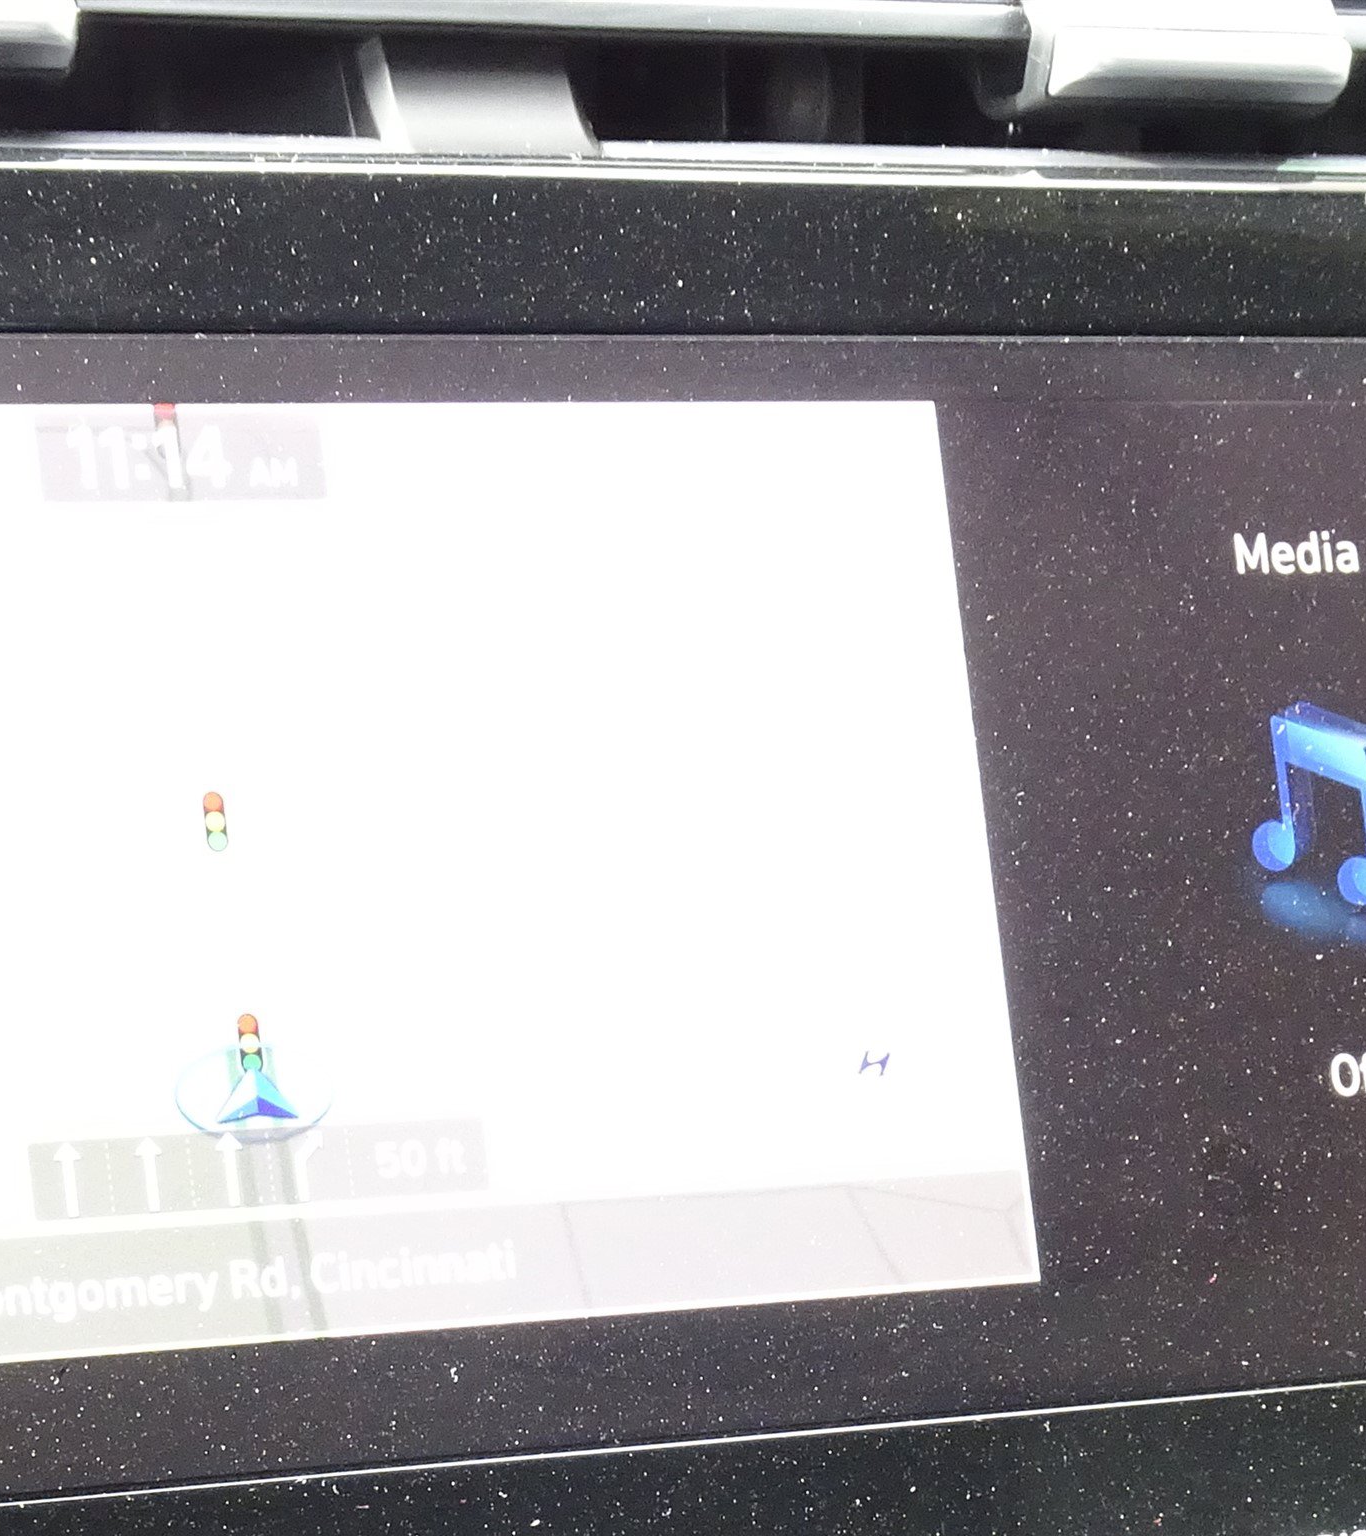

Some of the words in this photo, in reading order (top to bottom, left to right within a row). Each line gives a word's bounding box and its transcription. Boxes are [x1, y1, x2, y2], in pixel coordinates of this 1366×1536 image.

[67, 422, 233, 491] 11:14
[248, 455, 299, 489] AM
[1232, 531, 1361, 577] Media
[310, 1239, 517, 1296] Cincinnati
